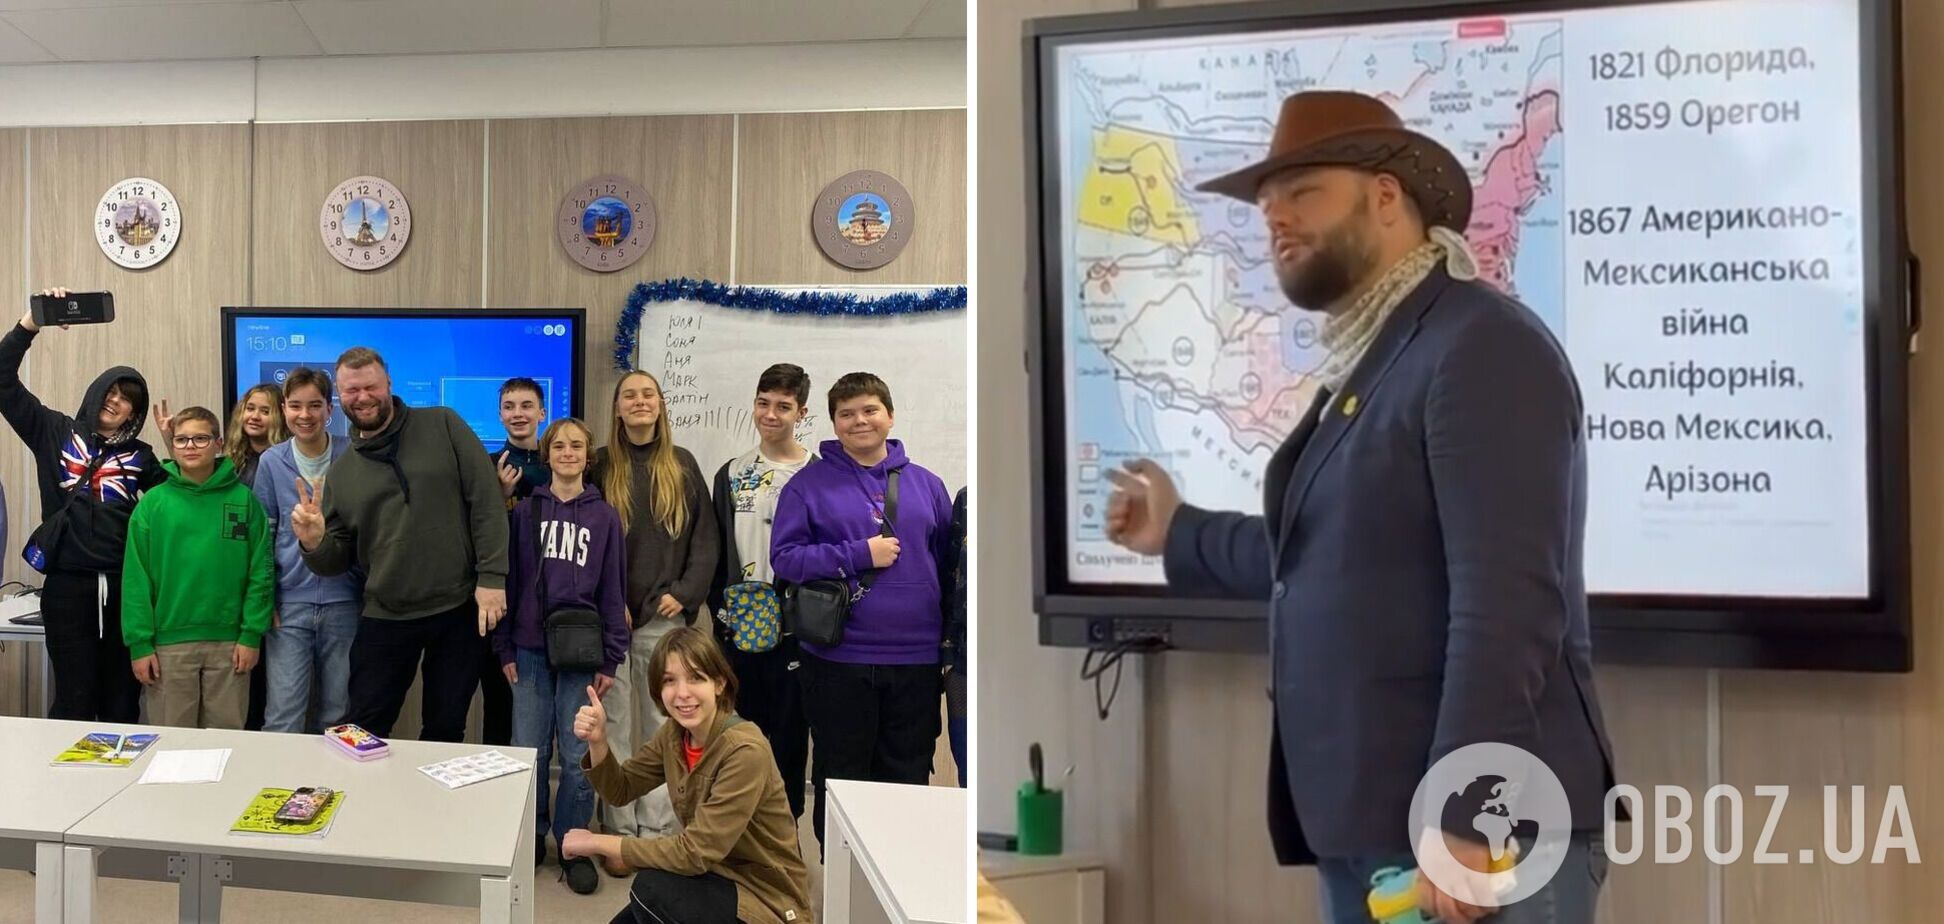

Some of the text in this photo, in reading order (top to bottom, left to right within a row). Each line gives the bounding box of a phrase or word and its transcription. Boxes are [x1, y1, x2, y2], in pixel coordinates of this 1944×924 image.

[1589, 44, 1816, 81] 1821 Флорида,
[1605, 99, 1801, 134] 1859 Орегон
[132, 186, 144, 196] 12
[358, 186, 369, 194] 12
[589, 189, 598, 197] 11
[605, 184, 616, 193] 12
[118, 191, 128, 200] 11
[151, 191, 156, 200] 1
[343, 191, 352, 200] 11
[377, 190, 382, 198] 1
[625, 191, 630, 199] 1
[106, 203, 118, 212] 10
[161, 202, 167, 212] 2
[331, 204, 342, 213] 10
[389, 200, 395, 209] 2
[575, 200, 586, 209] 10
[635, 204, 641, 212] 2
[104, 218, 110, 228] 9
[165, 218, 170, 227] 3
[394, 216, 400, 225] 3
[571, 216, 577, 225] 9
[1568, 205, 1843, 239] 1867 Американо-
[330, 221, 336, 230] 9
[638, 221, 644, 230] 3
[108, 235, 114, 243] 8
[160, 234, 166, 243] 4
[336, 237, 342, 246] 8
[391, 233, 396, 242] 4
[574, 234, 579, 243] 8
[632, 238, 637, 246] 4
[120, 246, 125, 254] 7
[134, 250, 140, 259] 6
[149, 246, 155, 254] 5
[348, 248, 354, 257] 7
[380, 246, 386, 255] 5
[585, 246, 590, 255] 7
[618, 249, 624, 258] 5
[364, 251, 370, 260] 6
[600, 252, 607, 260] 6
[1584, 258, 1830, 286] Мексиканська
[1661, 308, 1749, 337] війна
[246, 336, 287, 351] 15:10
[1604, 360, 1804, 396] Каліфорнія,
[1586, 412, 1833, 442] Нова Мексика,
[1645, 464, 1772, 501] Арізона
